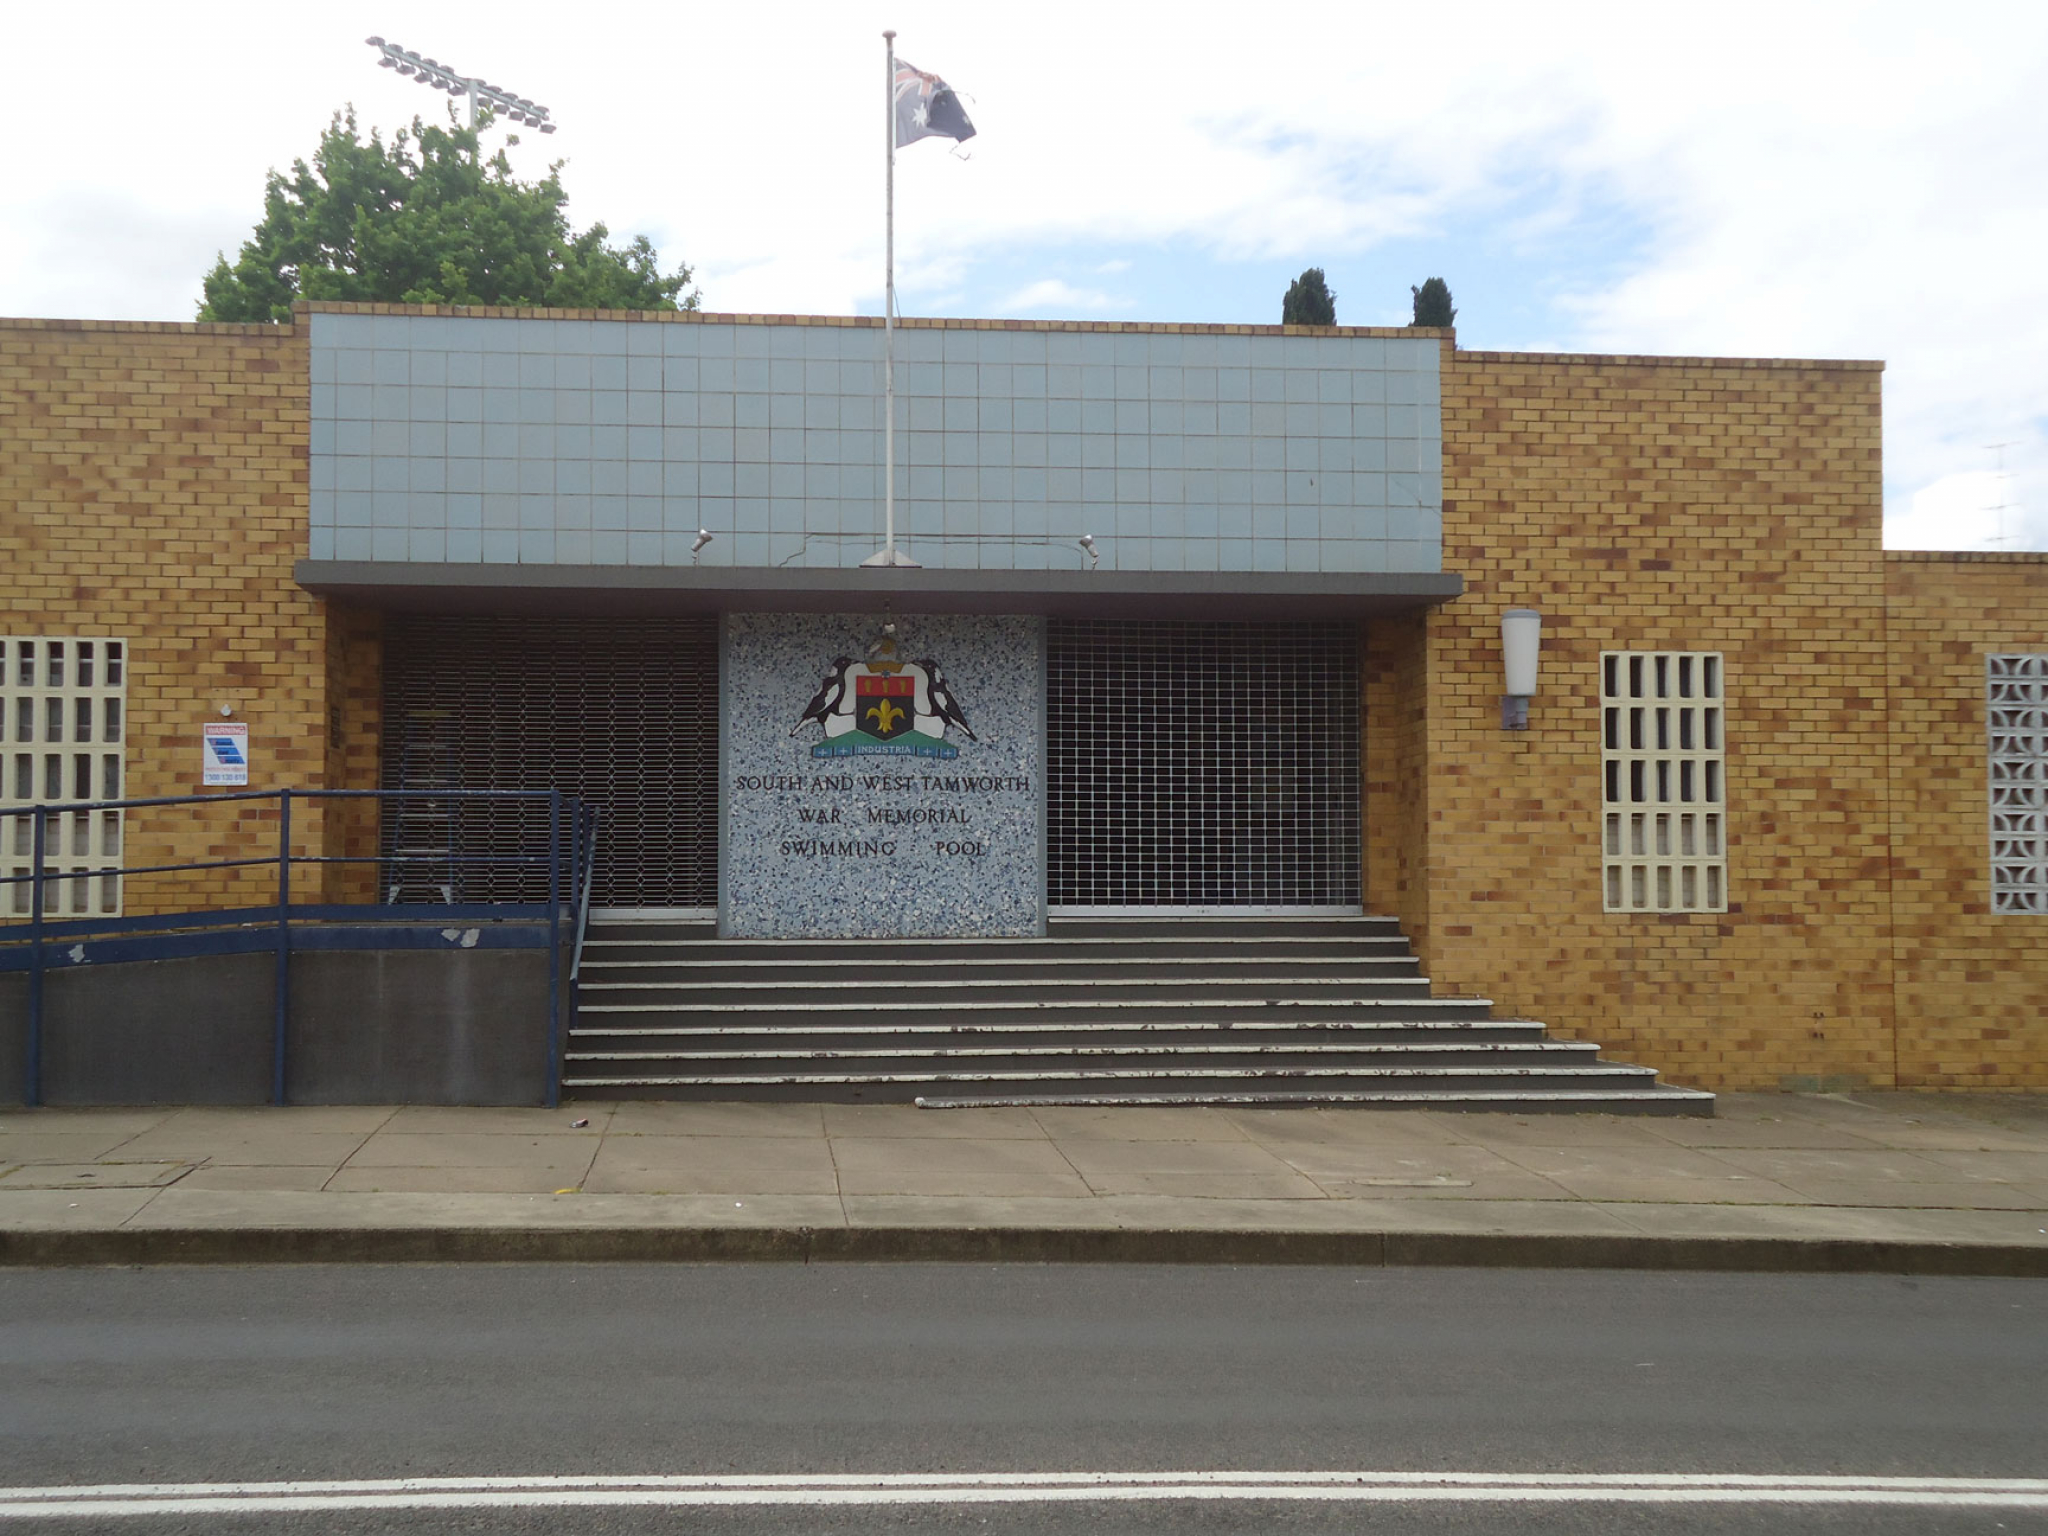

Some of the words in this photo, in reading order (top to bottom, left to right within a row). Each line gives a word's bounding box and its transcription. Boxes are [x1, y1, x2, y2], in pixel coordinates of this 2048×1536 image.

[207, 726, 245, 735] WARNING
[858, 745, 911, 754] INDUSTRIA
[736, 775, 802, 791] SOUTH
[811, 775, 854, 791] AND
[863, 775, 912, 792] WEST
[922, 776, 1030, 793] TAMWORTH
[798, 808, 841, 824] WAR
[868, 808, 972, 824] MEMORIAL
[781, 840, 897, 857] SWIMMING
[935, 840, 987, 857] POOL
